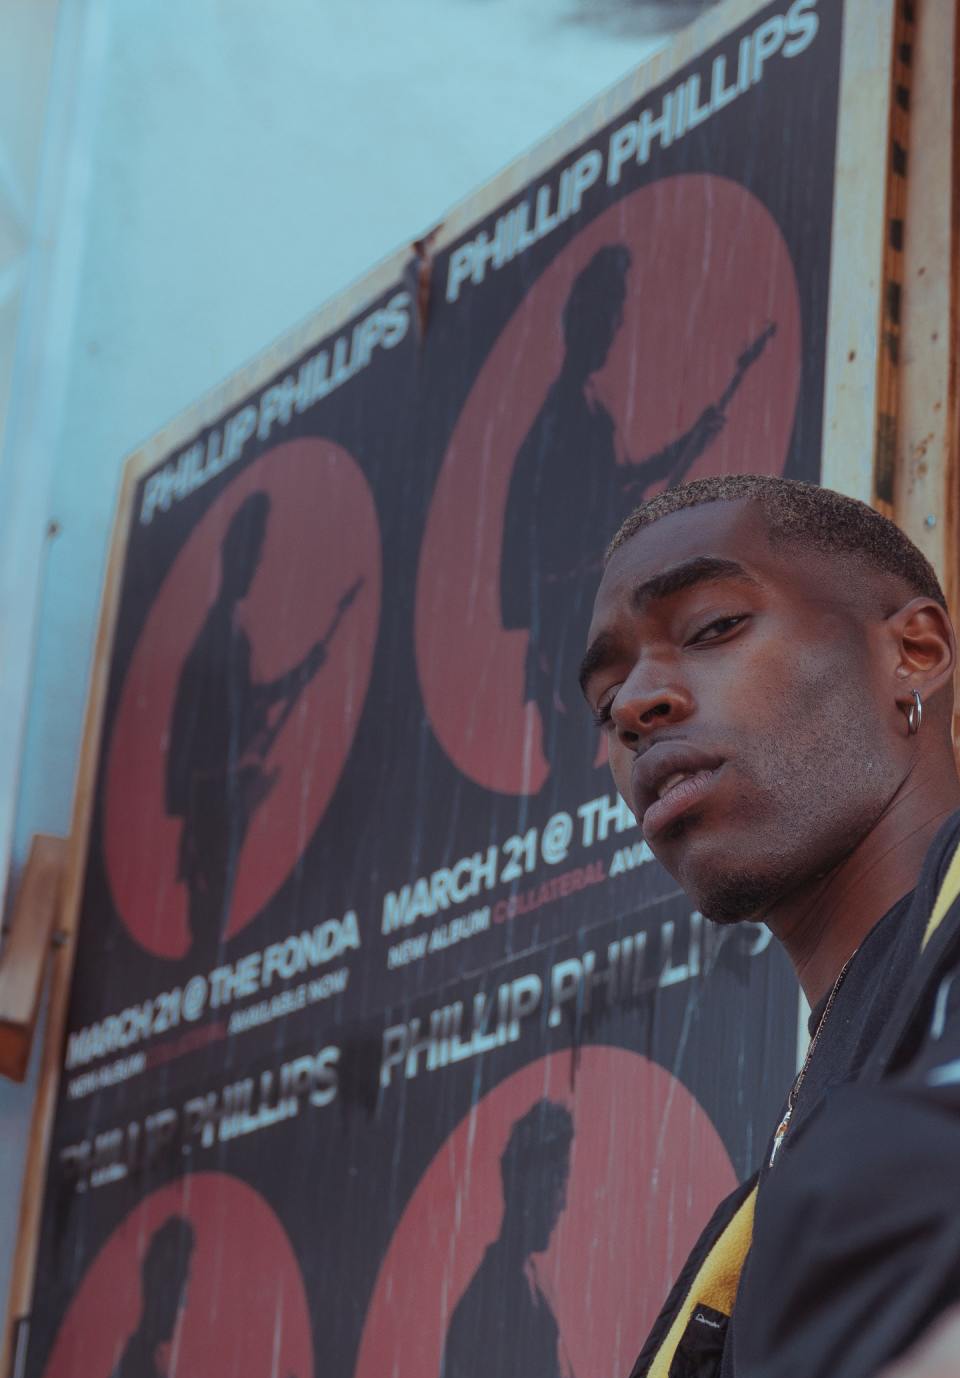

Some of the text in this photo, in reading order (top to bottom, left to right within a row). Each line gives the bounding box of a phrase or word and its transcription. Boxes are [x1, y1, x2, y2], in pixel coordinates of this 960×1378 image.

[445, 0, 820, 303] PHILLIP PHILLIPS
[139, 291, 411, 526] PHILLIP PHILLIPS
[382, 845, 499, 935] MARCH
[500, 827, 539, 884] 21
[541, 811, 573, 866] @
[387, 931, 429, 970] NEW
[428, 905, 491, 954] ALBUM
[65, 999, 152, 1070] MARCH
[208, 950, 262, 1008] THE
[261, 908, 361, 988] FONDA
[379, 973, 543, 1088] PHILLIP
